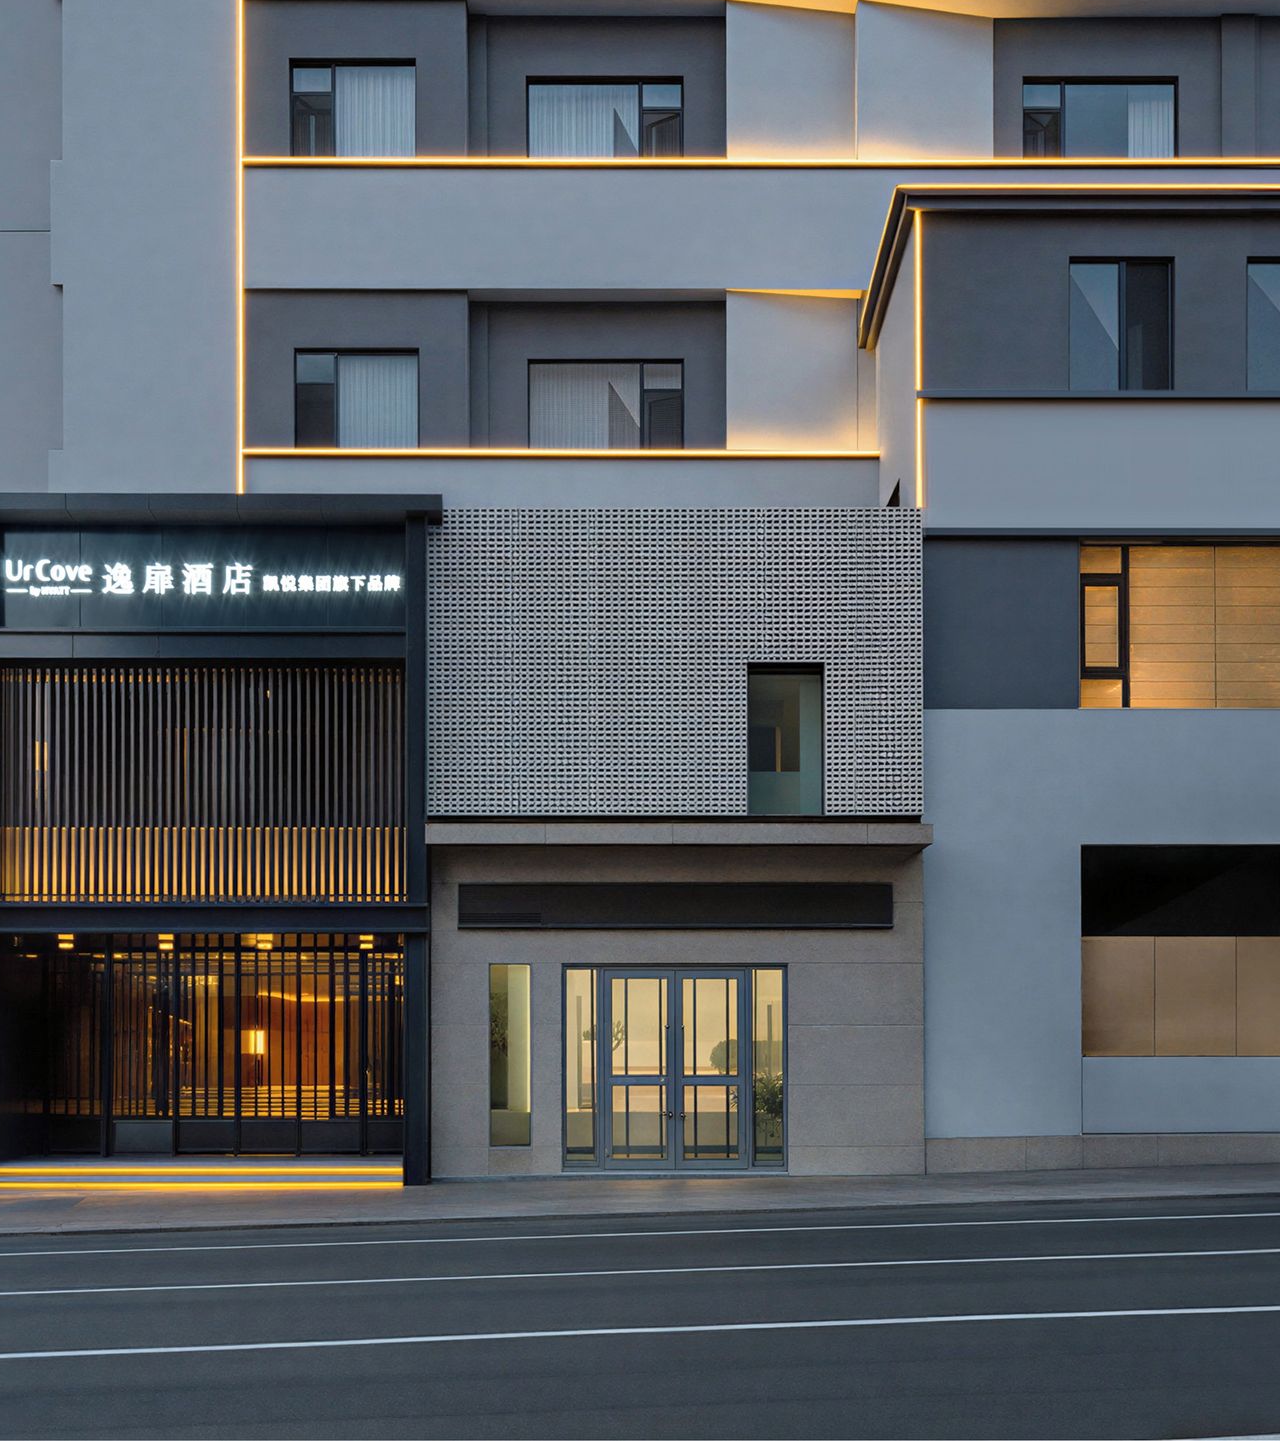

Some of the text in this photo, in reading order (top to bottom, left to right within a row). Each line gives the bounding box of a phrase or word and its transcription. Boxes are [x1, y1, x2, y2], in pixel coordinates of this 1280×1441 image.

[5, 558, 93, 582] UrCove
[101, 561, 254, 595] 逸扉酒店
